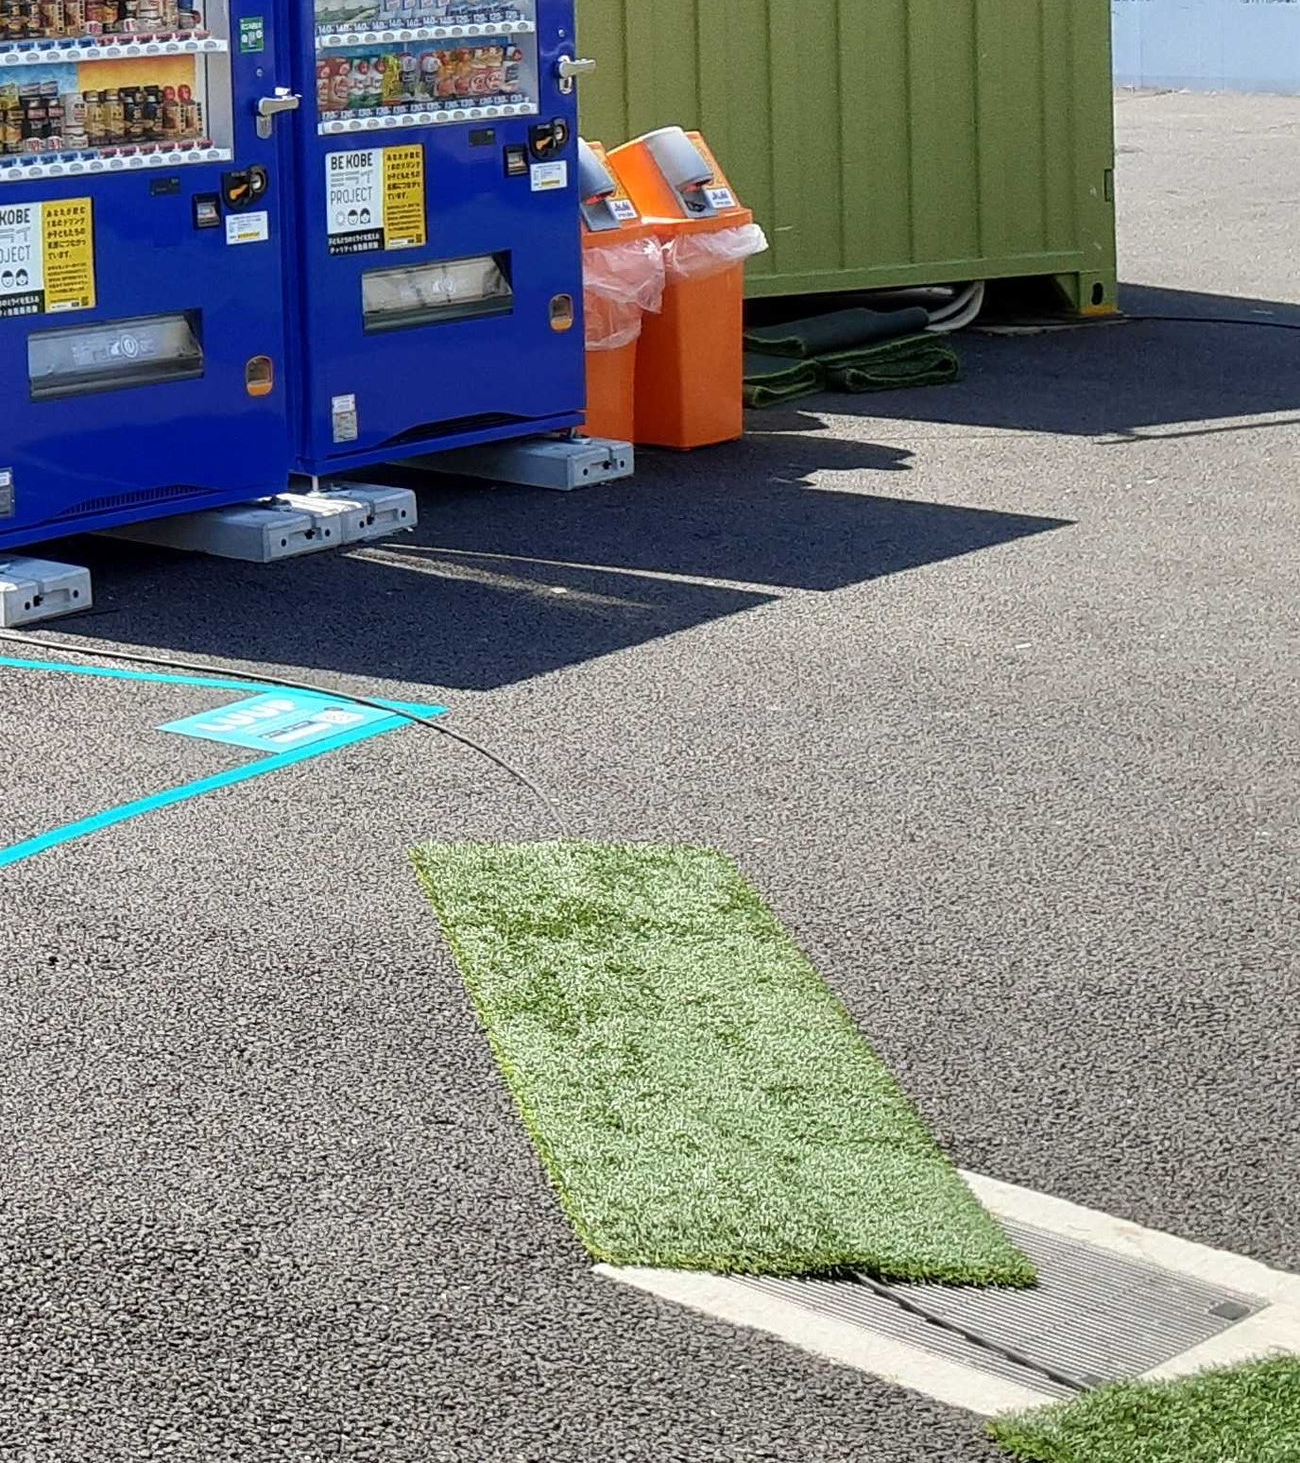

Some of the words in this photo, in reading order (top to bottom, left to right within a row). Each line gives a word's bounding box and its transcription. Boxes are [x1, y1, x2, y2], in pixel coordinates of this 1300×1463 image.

[331, 155, 344, 170] BE
[346, 152, 373, 168] KOBE
[330, 170, 373, 187] ミライ
[331, 186, 372, 205] PROJECT
[0, 208, 31, 226] KOBE
